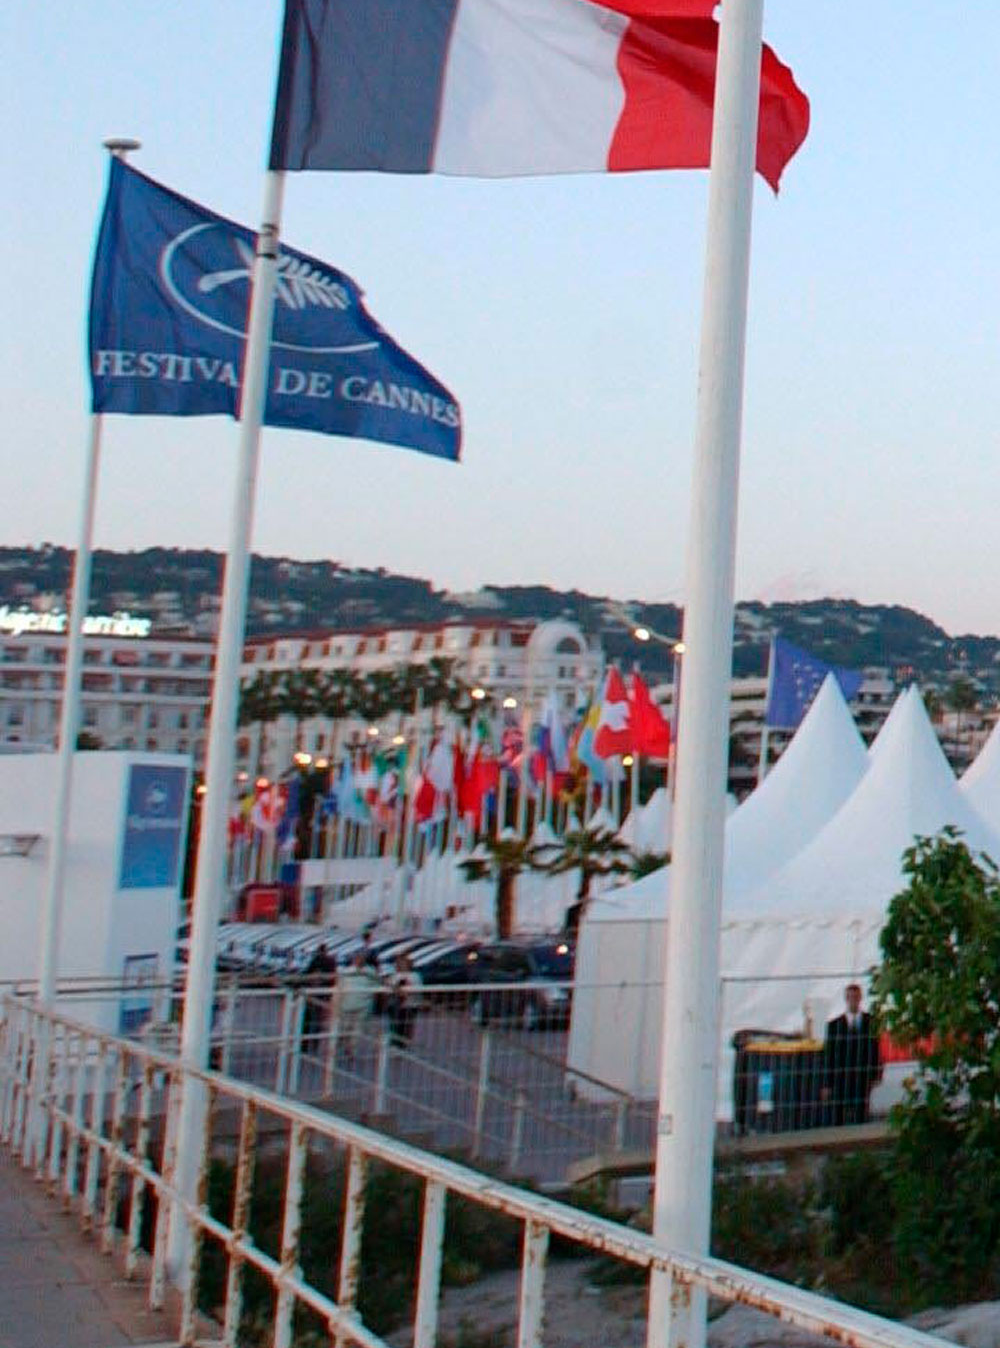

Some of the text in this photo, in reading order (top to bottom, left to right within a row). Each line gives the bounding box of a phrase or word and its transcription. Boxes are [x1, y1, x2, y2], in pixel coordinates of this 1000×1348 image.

[94, 349, 460, 428] FESTIVA DE CANNES
